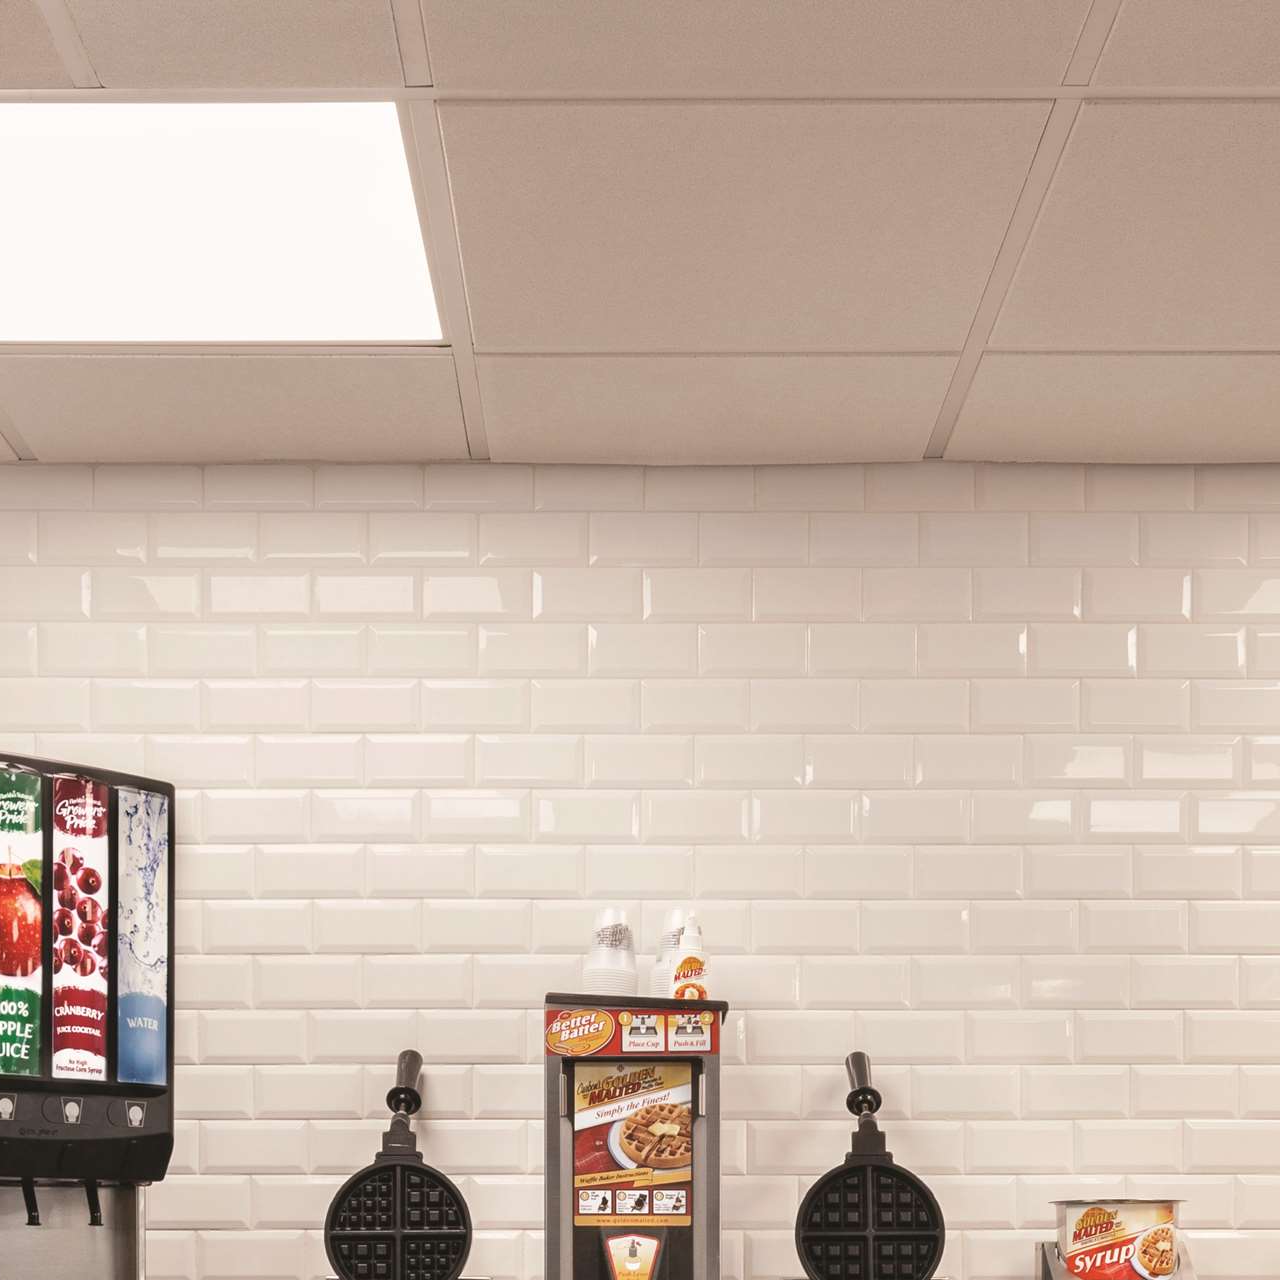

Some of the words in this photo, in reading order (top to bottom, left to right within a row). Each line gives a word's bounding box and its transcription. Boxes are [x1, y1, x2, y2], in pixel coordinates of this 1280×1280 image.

[674, 967, 704, 984] MALTED
[54, 1004, 104, 1021] CRANBERRY
[552, 1012, 598, 1034] Better
[126, 1017, 159, 1031] WATER
[560, 1021, 607, 1041] Batter
[628, 1040, 646, 1048] Place
[646, 1040, 660, 1049] Cup
[602, 1066, 657, 1089] GOLDEN
[588, 1081, 642, 1105] MALTED
[594, 1106, 623, 1119] Simply
[626, 1100, 640, 1110] the
[641, 1091, 671, 1107] Finest!
[579, 1176, 598, 1184] Waffle
[616, 1170, 650, 1180] Instructions
[1072, 1220, 1114, 1243] MALTED
[1074, 1244, 1136, 1273] Syrup
